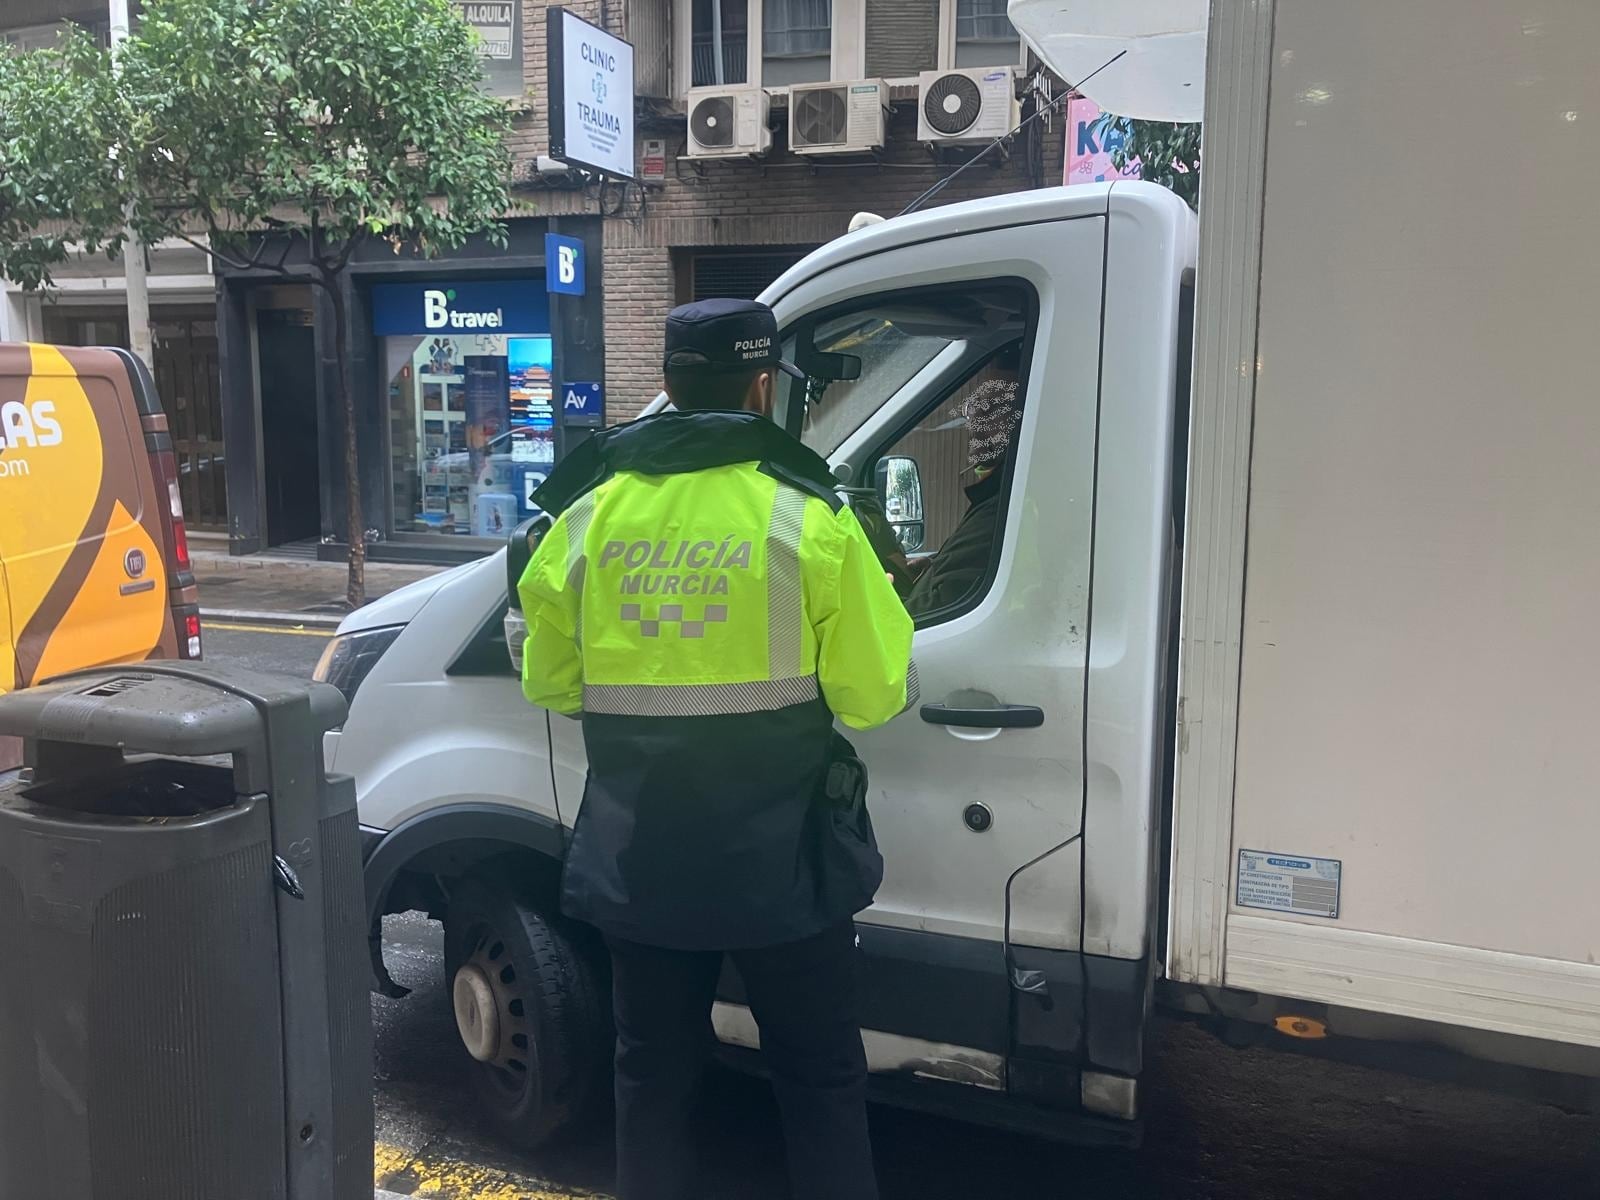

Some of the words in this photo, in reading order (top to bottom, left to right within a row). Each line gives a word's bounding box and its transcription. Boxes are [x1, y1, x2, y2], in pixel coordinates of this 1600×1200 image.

[466, 5, 511, 23] ALQUILA
[581, 42, 615, 72] CLINIC
[577, 101, 621, 135] TRAUMA
[558, 245, 576, 284] B
[450, 308, 503, 328] travel
[742, 350, 769, 360] MURCIA
[564, 390, 587, 409] Av
[598, 534, 752, 569] POLICÍA
[619, 574, 729, 595] MURCIA
